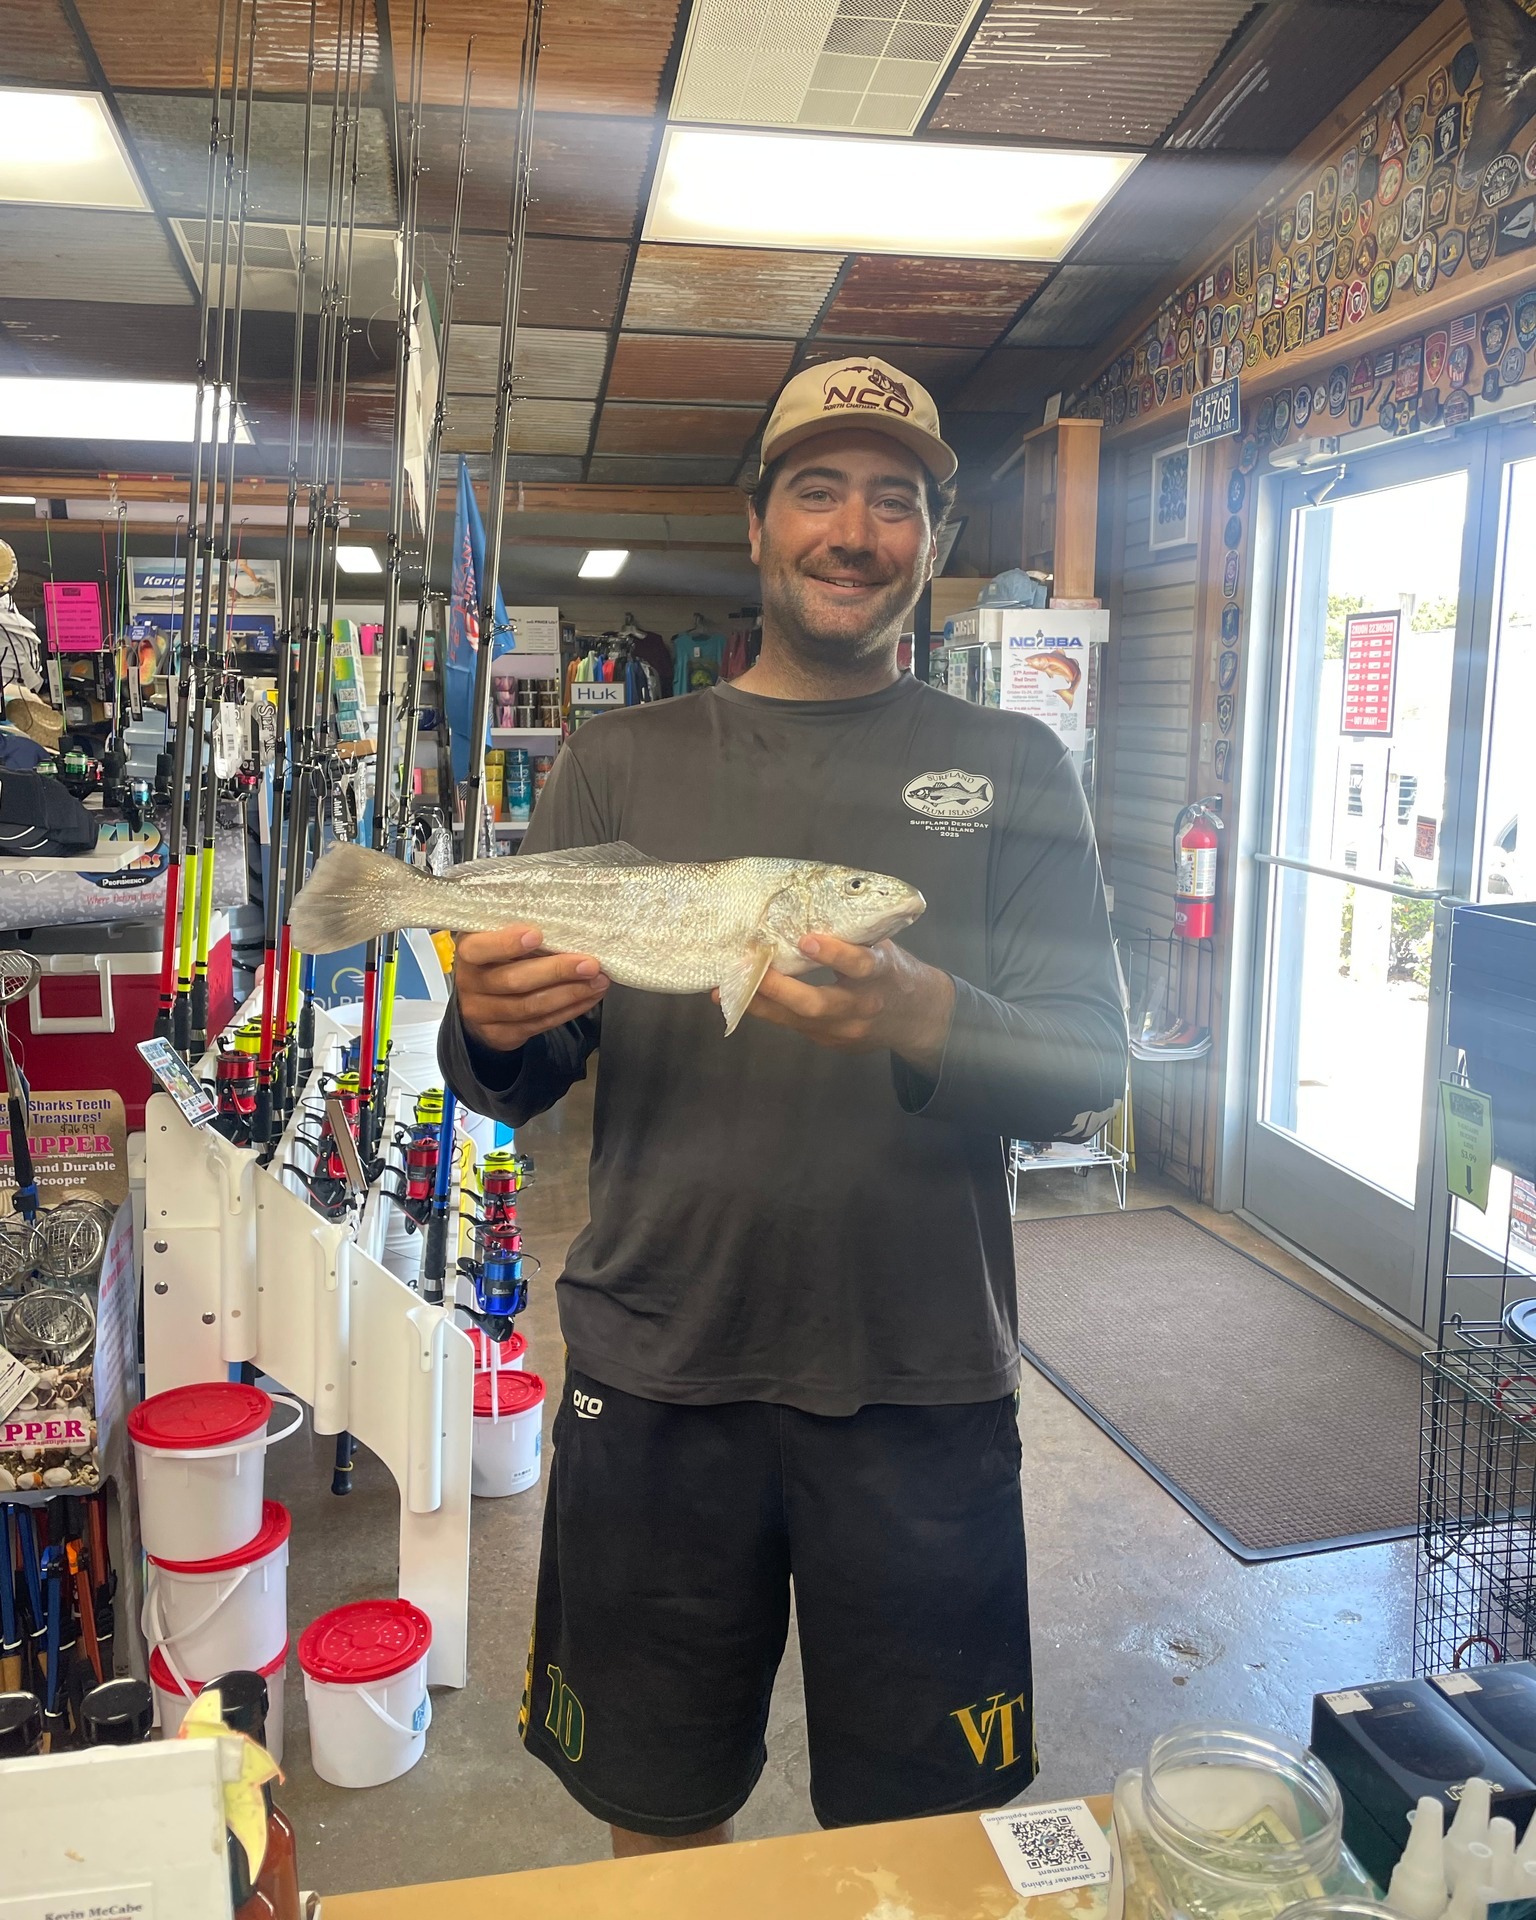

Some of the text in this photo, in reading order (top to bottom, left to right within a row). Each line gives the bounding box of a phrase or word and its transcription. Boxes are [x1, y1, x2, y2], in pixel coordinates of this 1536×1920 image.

[1437, 106, 1457, 126] POLICE
[1484, 157, 1519, 188] KANNAPOLIS
[1489, 186, 1510, 201] POLICE
[824, 386, 911, 417] NCO
[1200, 394, 1231, 430] 15709
[143, 576, 201, 586] Korkes
[926, 772, 975, 784] SURFLAND
[921, 804, 980, 816] PLUM ISLAND
[909, 819, 989, 829] SURFLAND DEMO DAY
[947, 825, 975, 834] ISLAND
[29, 1099, 111, 1111] Sharks Teeth
[32, 1112, 103, 1124] Treasures!
[1460, 1149, 1477, 1163] $3.99
[34, 1161, 116, 1173] and Durable
[33, 1176, 87, 1187] Scooper
[0, 1420, 86, 1442] PPER
[1325, 1692, 1350, 1702] 20.49
[544, 1663, 585, 1762] 10
[949, 1692, 1025, 1771] VT
[986, 1805, 1083, 1823] Online Citation Application
[1038, 1863, 1091, 1876] Tournament
[1020, 1879, 1054, 1889] Fishing
[1054, 1872, 1096, 1884] Saltwater
[44, 1903, 143, 1920] Kevin McCabe
